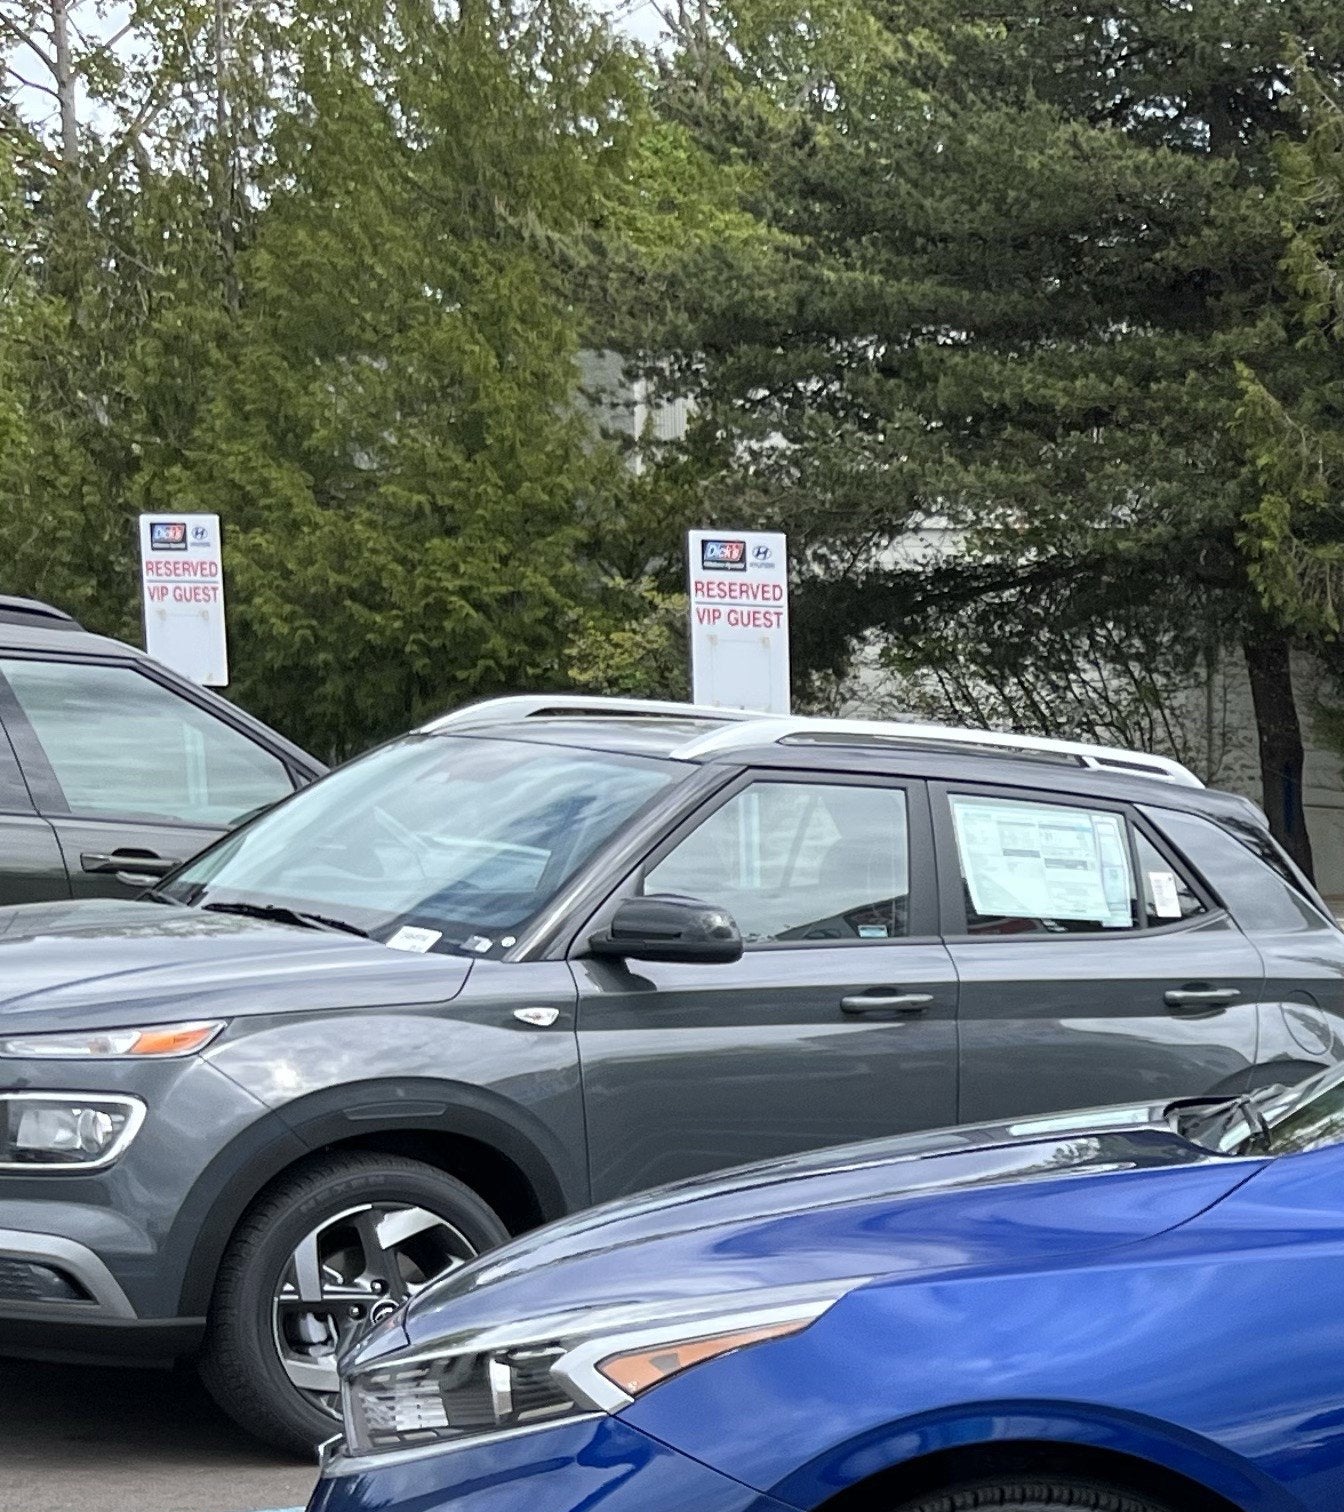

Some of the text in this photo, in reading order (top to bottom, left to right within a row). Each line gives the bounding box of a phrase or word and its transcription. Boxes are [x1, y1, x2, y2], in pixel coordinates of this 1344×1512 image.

[145, 561, 218, 577] RESERVED
[147, 586, 219, 603] VIP GUEST
[694, 580, 783, 601] RESERVED
[696, 607, 783, 628] VIP GUEST
